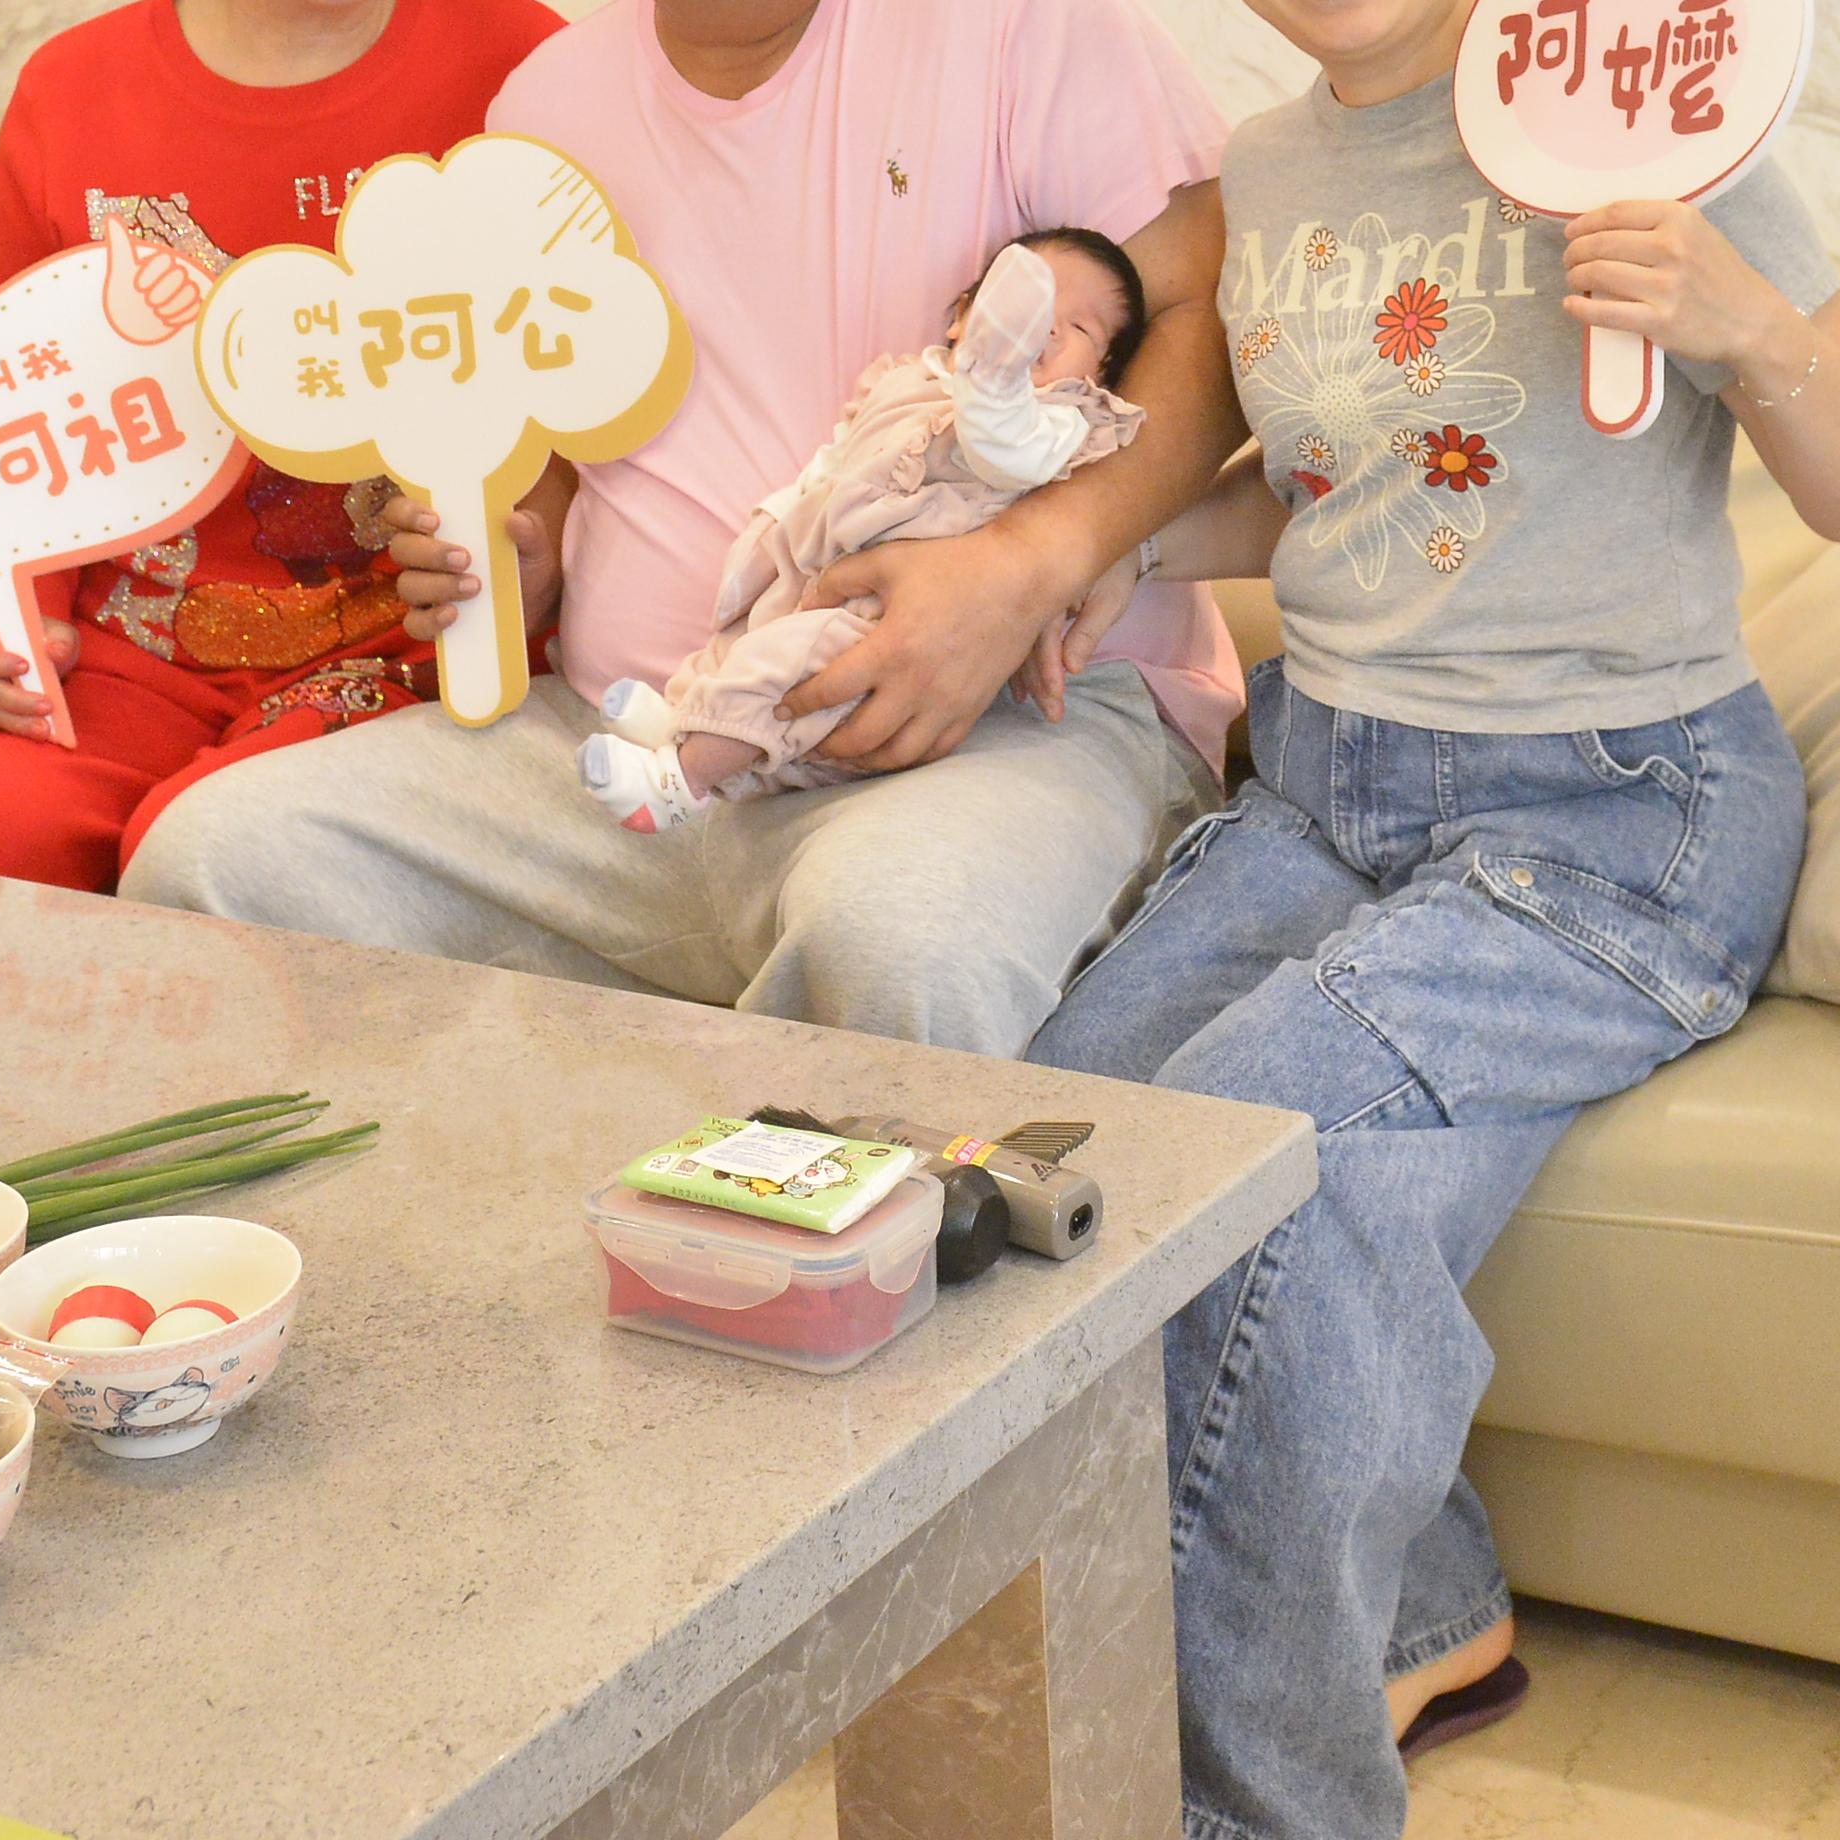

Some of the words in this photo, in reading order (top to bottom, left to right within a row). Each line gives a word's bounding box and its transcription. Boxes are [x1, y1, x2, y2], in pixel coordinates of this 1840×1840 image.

[1228, 196, 1536, 320] Mardi
[293, 298, 346, 399] 叫我
[359, 286, 593, 388] 阿公
